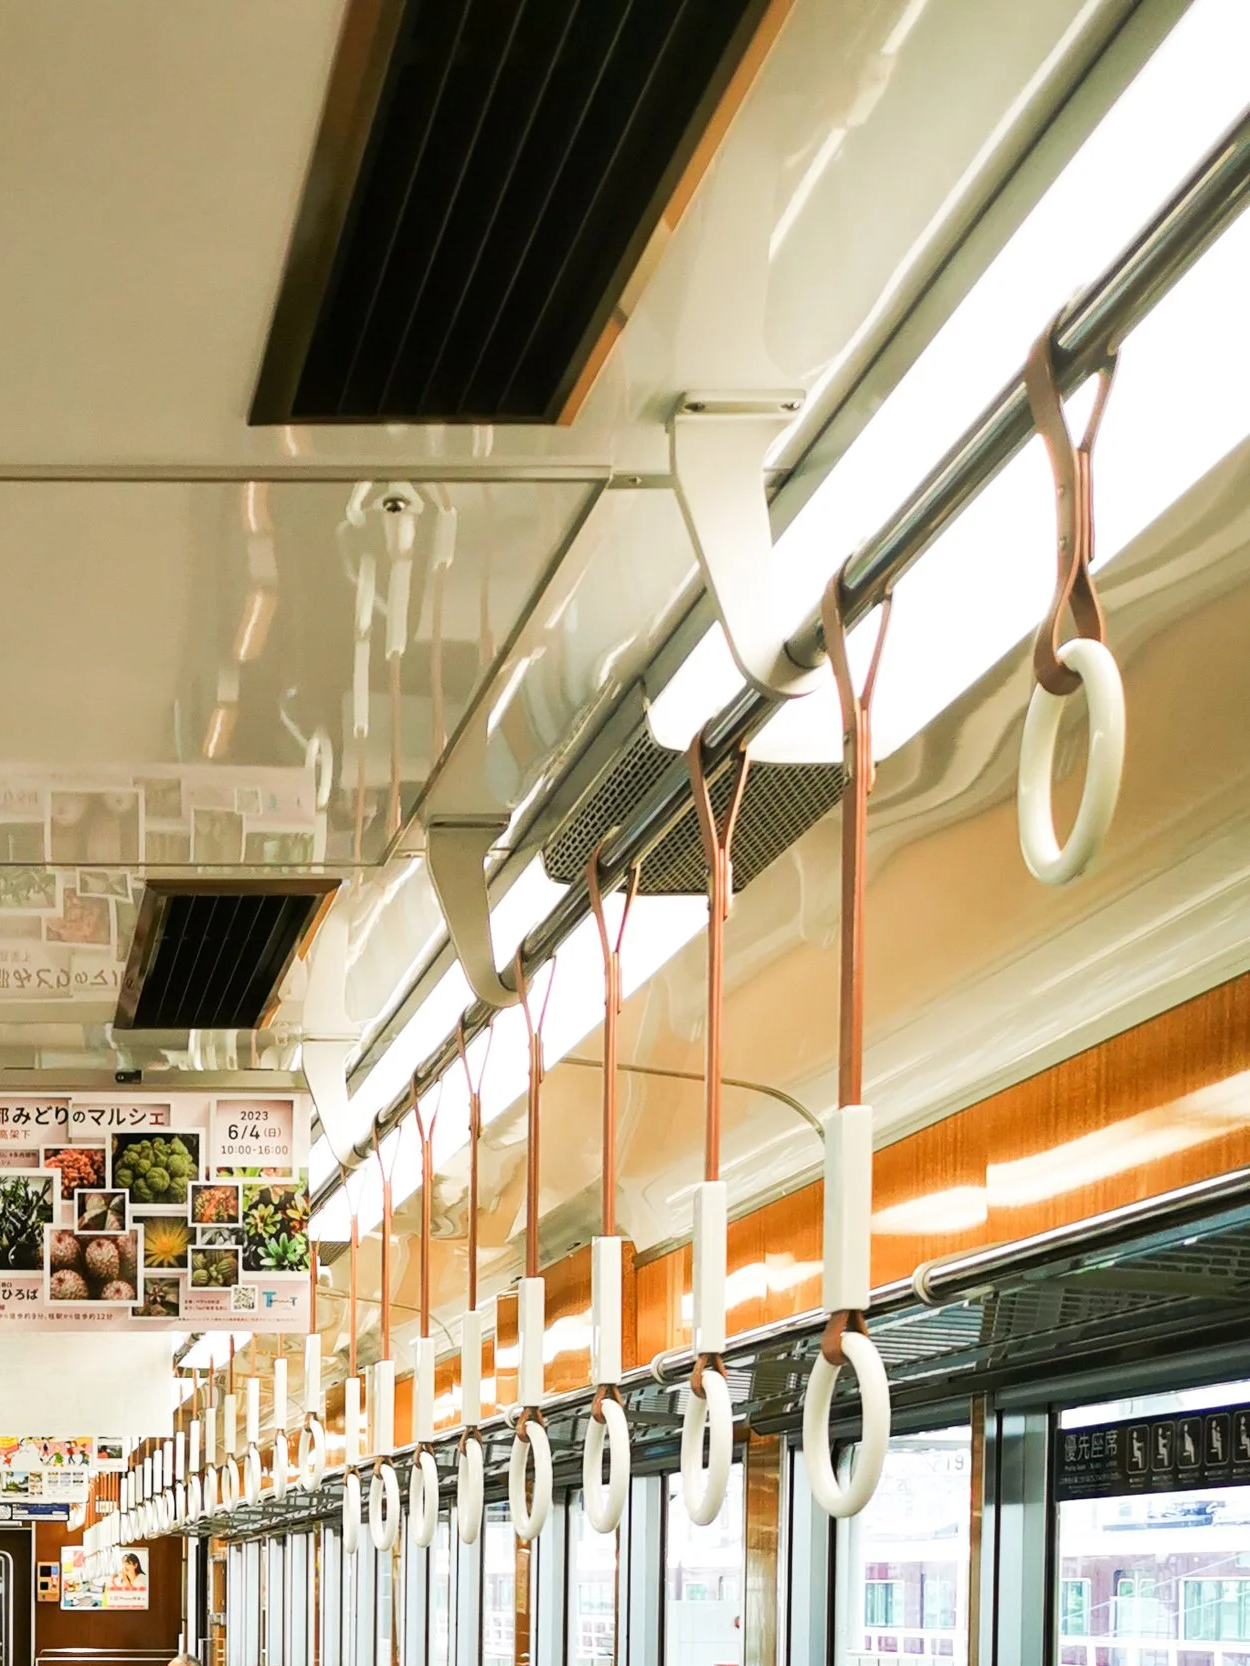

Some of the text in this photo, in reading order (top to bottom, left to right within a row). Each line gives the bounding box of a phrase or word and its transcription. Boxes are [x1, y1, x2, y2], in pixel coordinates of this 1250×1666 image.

[240, 1111, 269, 1120] 2023
[221, 1145, 288, 1155] 10:00-16:00
[1064, 1430, 1118, 1463] 優先座席
